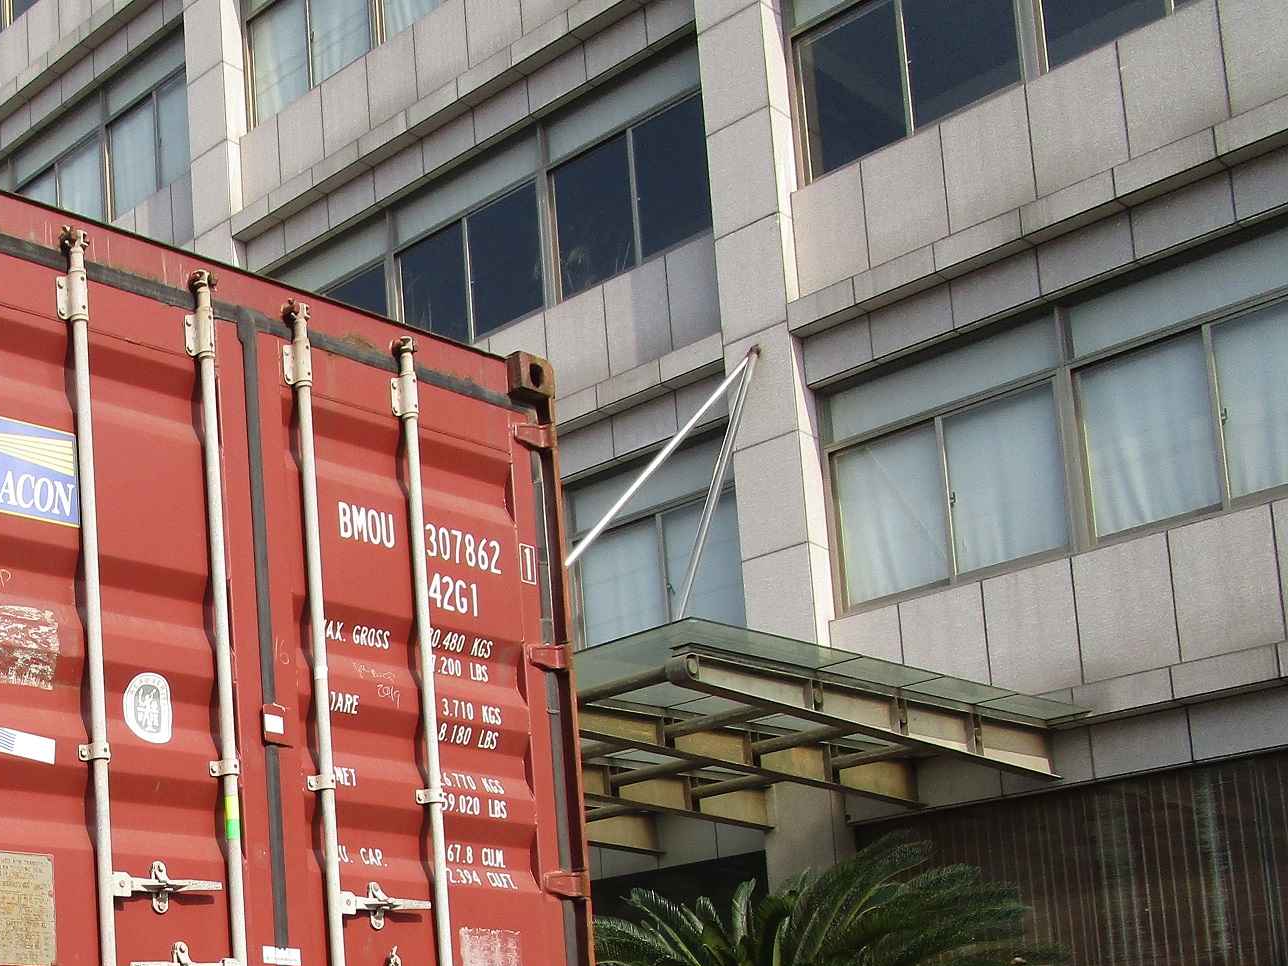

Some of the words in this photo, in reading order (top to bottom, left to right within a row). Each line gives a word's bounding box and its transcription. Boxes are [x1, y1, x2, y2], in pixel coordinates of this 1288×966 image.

[337, 500, 396, 549] BMOU
[425, 523, 502, 575] 307862
[522, 545, 534, 583] 1
[428, 572, 479, 618] 42G1
[323, 618, 347, 643] AX.
[352, 624, 391, 650] GROSS
[470, 637, 494, 659] KGS
[431, 653, 462, 678] 7.200
[469, 661, 489, 683] LBS
[329, 690, 360, 715] TARE
[481, 704, 502, 726] KGS
[477, 729, 500, 750] LBS
[333, 765, 357, 787] NET
[440, 771, 477, 791] 6.770
[480, 776, 505, 795] KGS
[487, 798, 508, 819] LBS
[336, 844, 354, 864] U.
[359, 846, 389, 867] CAP.
[447, 843, 474, 865] 67.8
